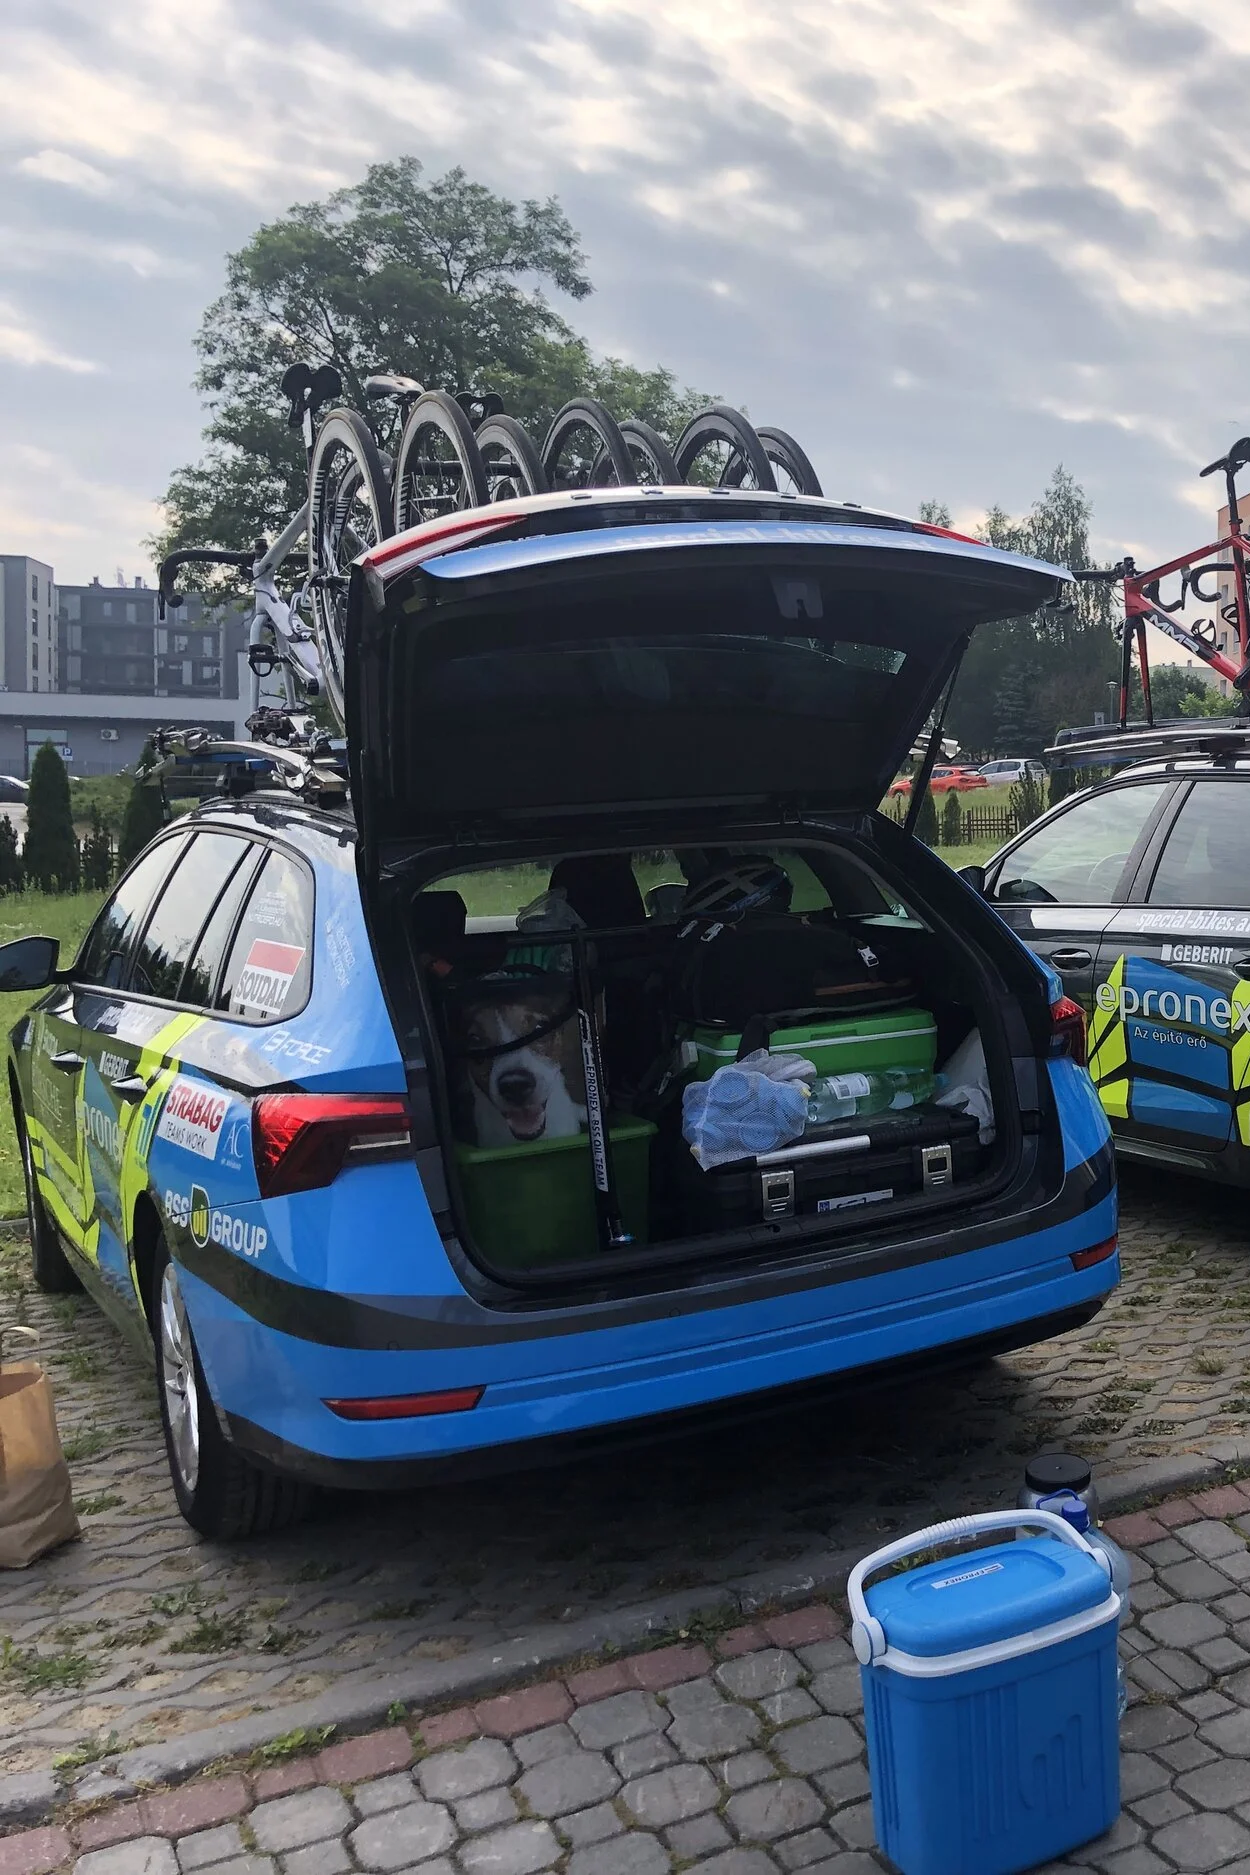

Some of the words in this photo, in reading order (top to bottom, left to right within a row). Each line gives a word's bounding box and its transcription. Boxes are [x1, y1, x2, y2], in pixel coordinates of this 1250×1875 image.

[1173, 944, 1234, 965] GEBERIT
[236, 969, 288, 1009] SOUDAL
[1134, 1026, 1149, 1041] Az
[1152, 1027, 1184, 1046] építő
[1187, 1033, 1208, 1049] erő
[166, 1083, 227, 1134] STRABAG
[586, 1064, 600, 1112] EPRONEX
[595, 1158, 606, 1187] TEAM
[165, 1121, 187, 1144] TEAMS
[223, 1121, 250, 1159] AC
[165, 1189, 191, 1228] BSS
[211, 1210, 268, 1258] GROUP
